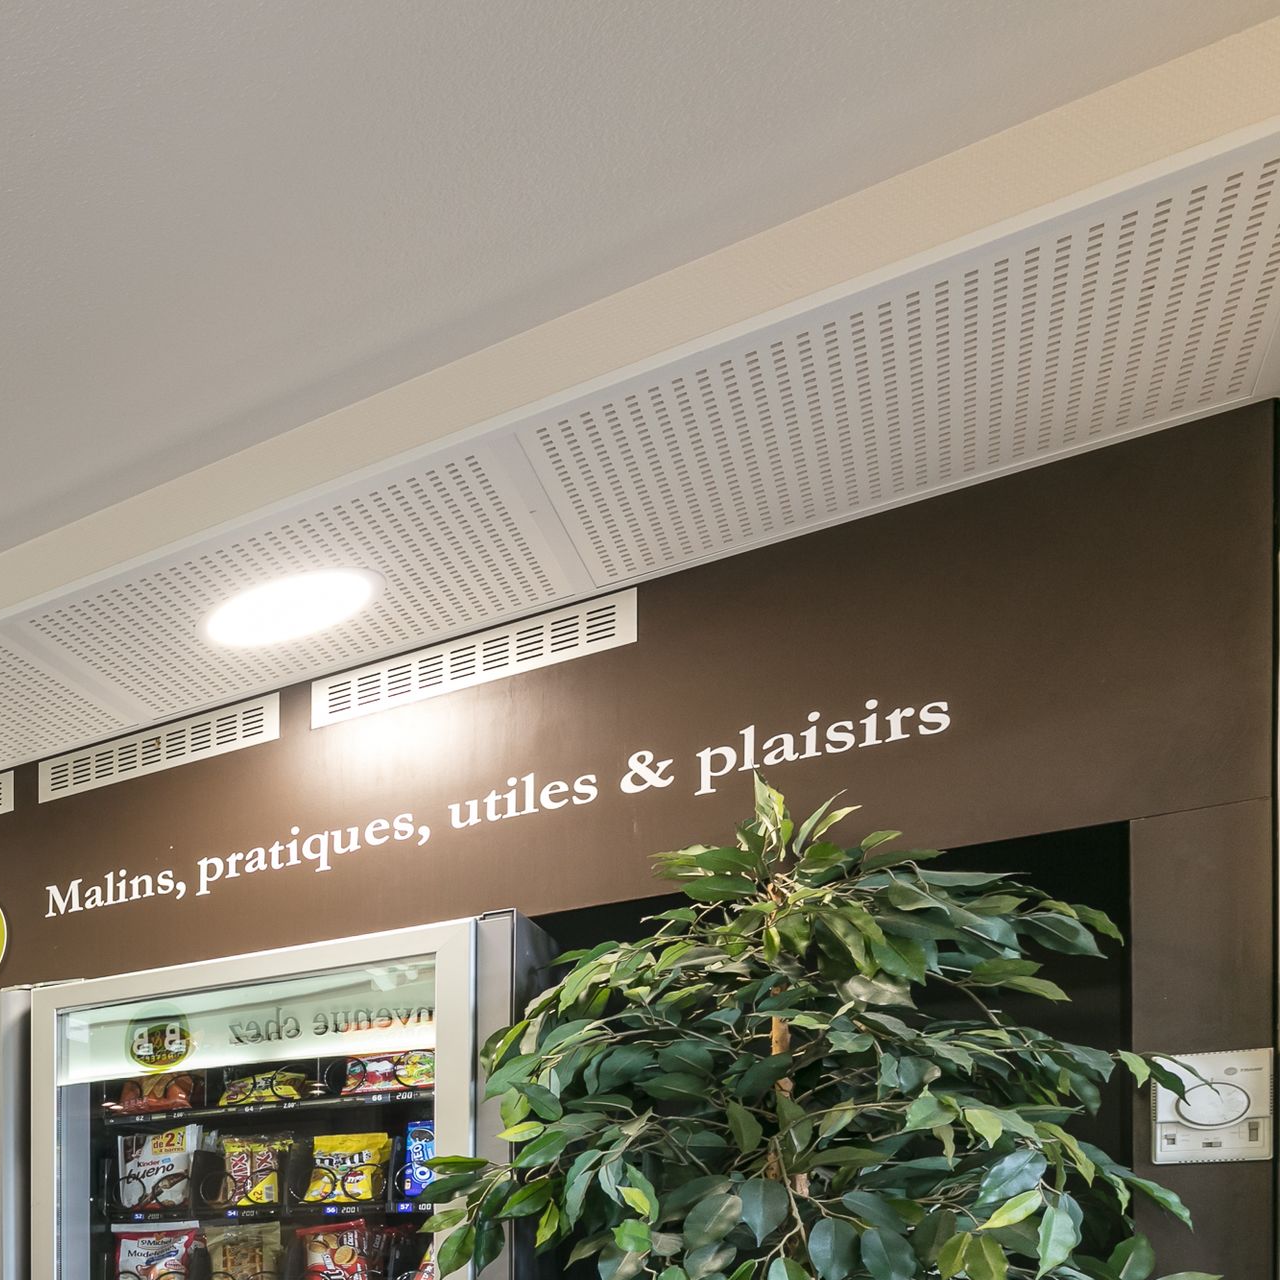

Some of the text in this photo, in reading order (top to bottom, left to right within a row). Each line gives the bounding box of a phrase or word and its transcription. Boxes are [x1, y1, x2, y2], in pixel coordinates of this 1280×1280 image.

[44, 697, 952, 919] Malins, pratiques, utiles & plaisirs
[153, 1132, 175, 1149] de 2
[126, 1162, 175, 1185] bueno
